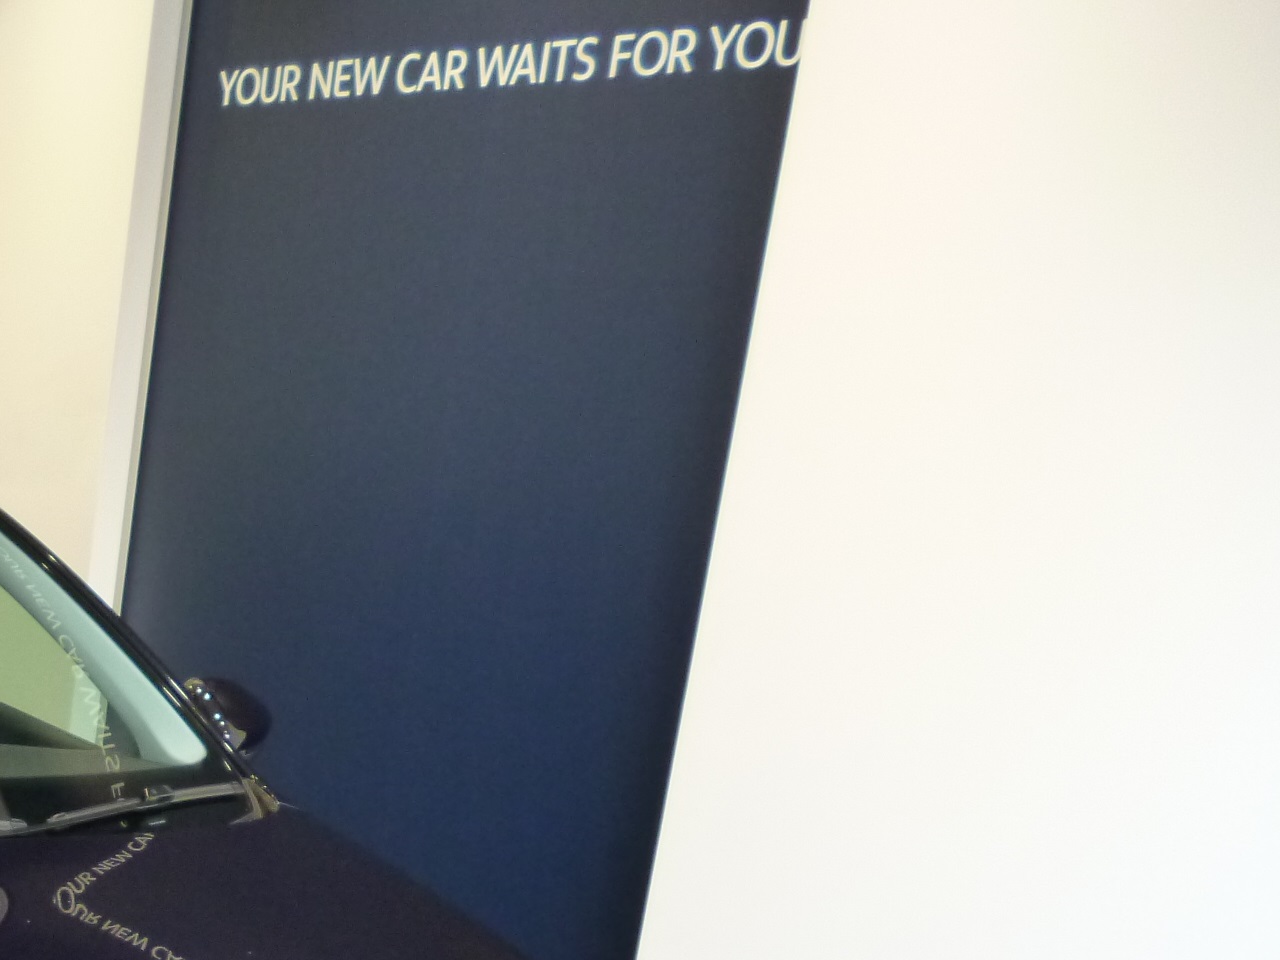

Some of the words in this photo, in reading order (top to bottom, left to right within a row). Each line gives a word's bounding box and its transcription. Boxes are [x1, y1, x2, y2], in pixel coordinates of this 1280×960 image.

[221, 63, 299, 106] YOUR
[309, 56, 391, 100] NEW
[396, 50, 465, 93] CAR
[478, 37, 598, 88] WAITS
[609, 28, 697, 77] FOR
[710, 19, 805, 70] YOU
[92, 850, 133, 875] NEW
